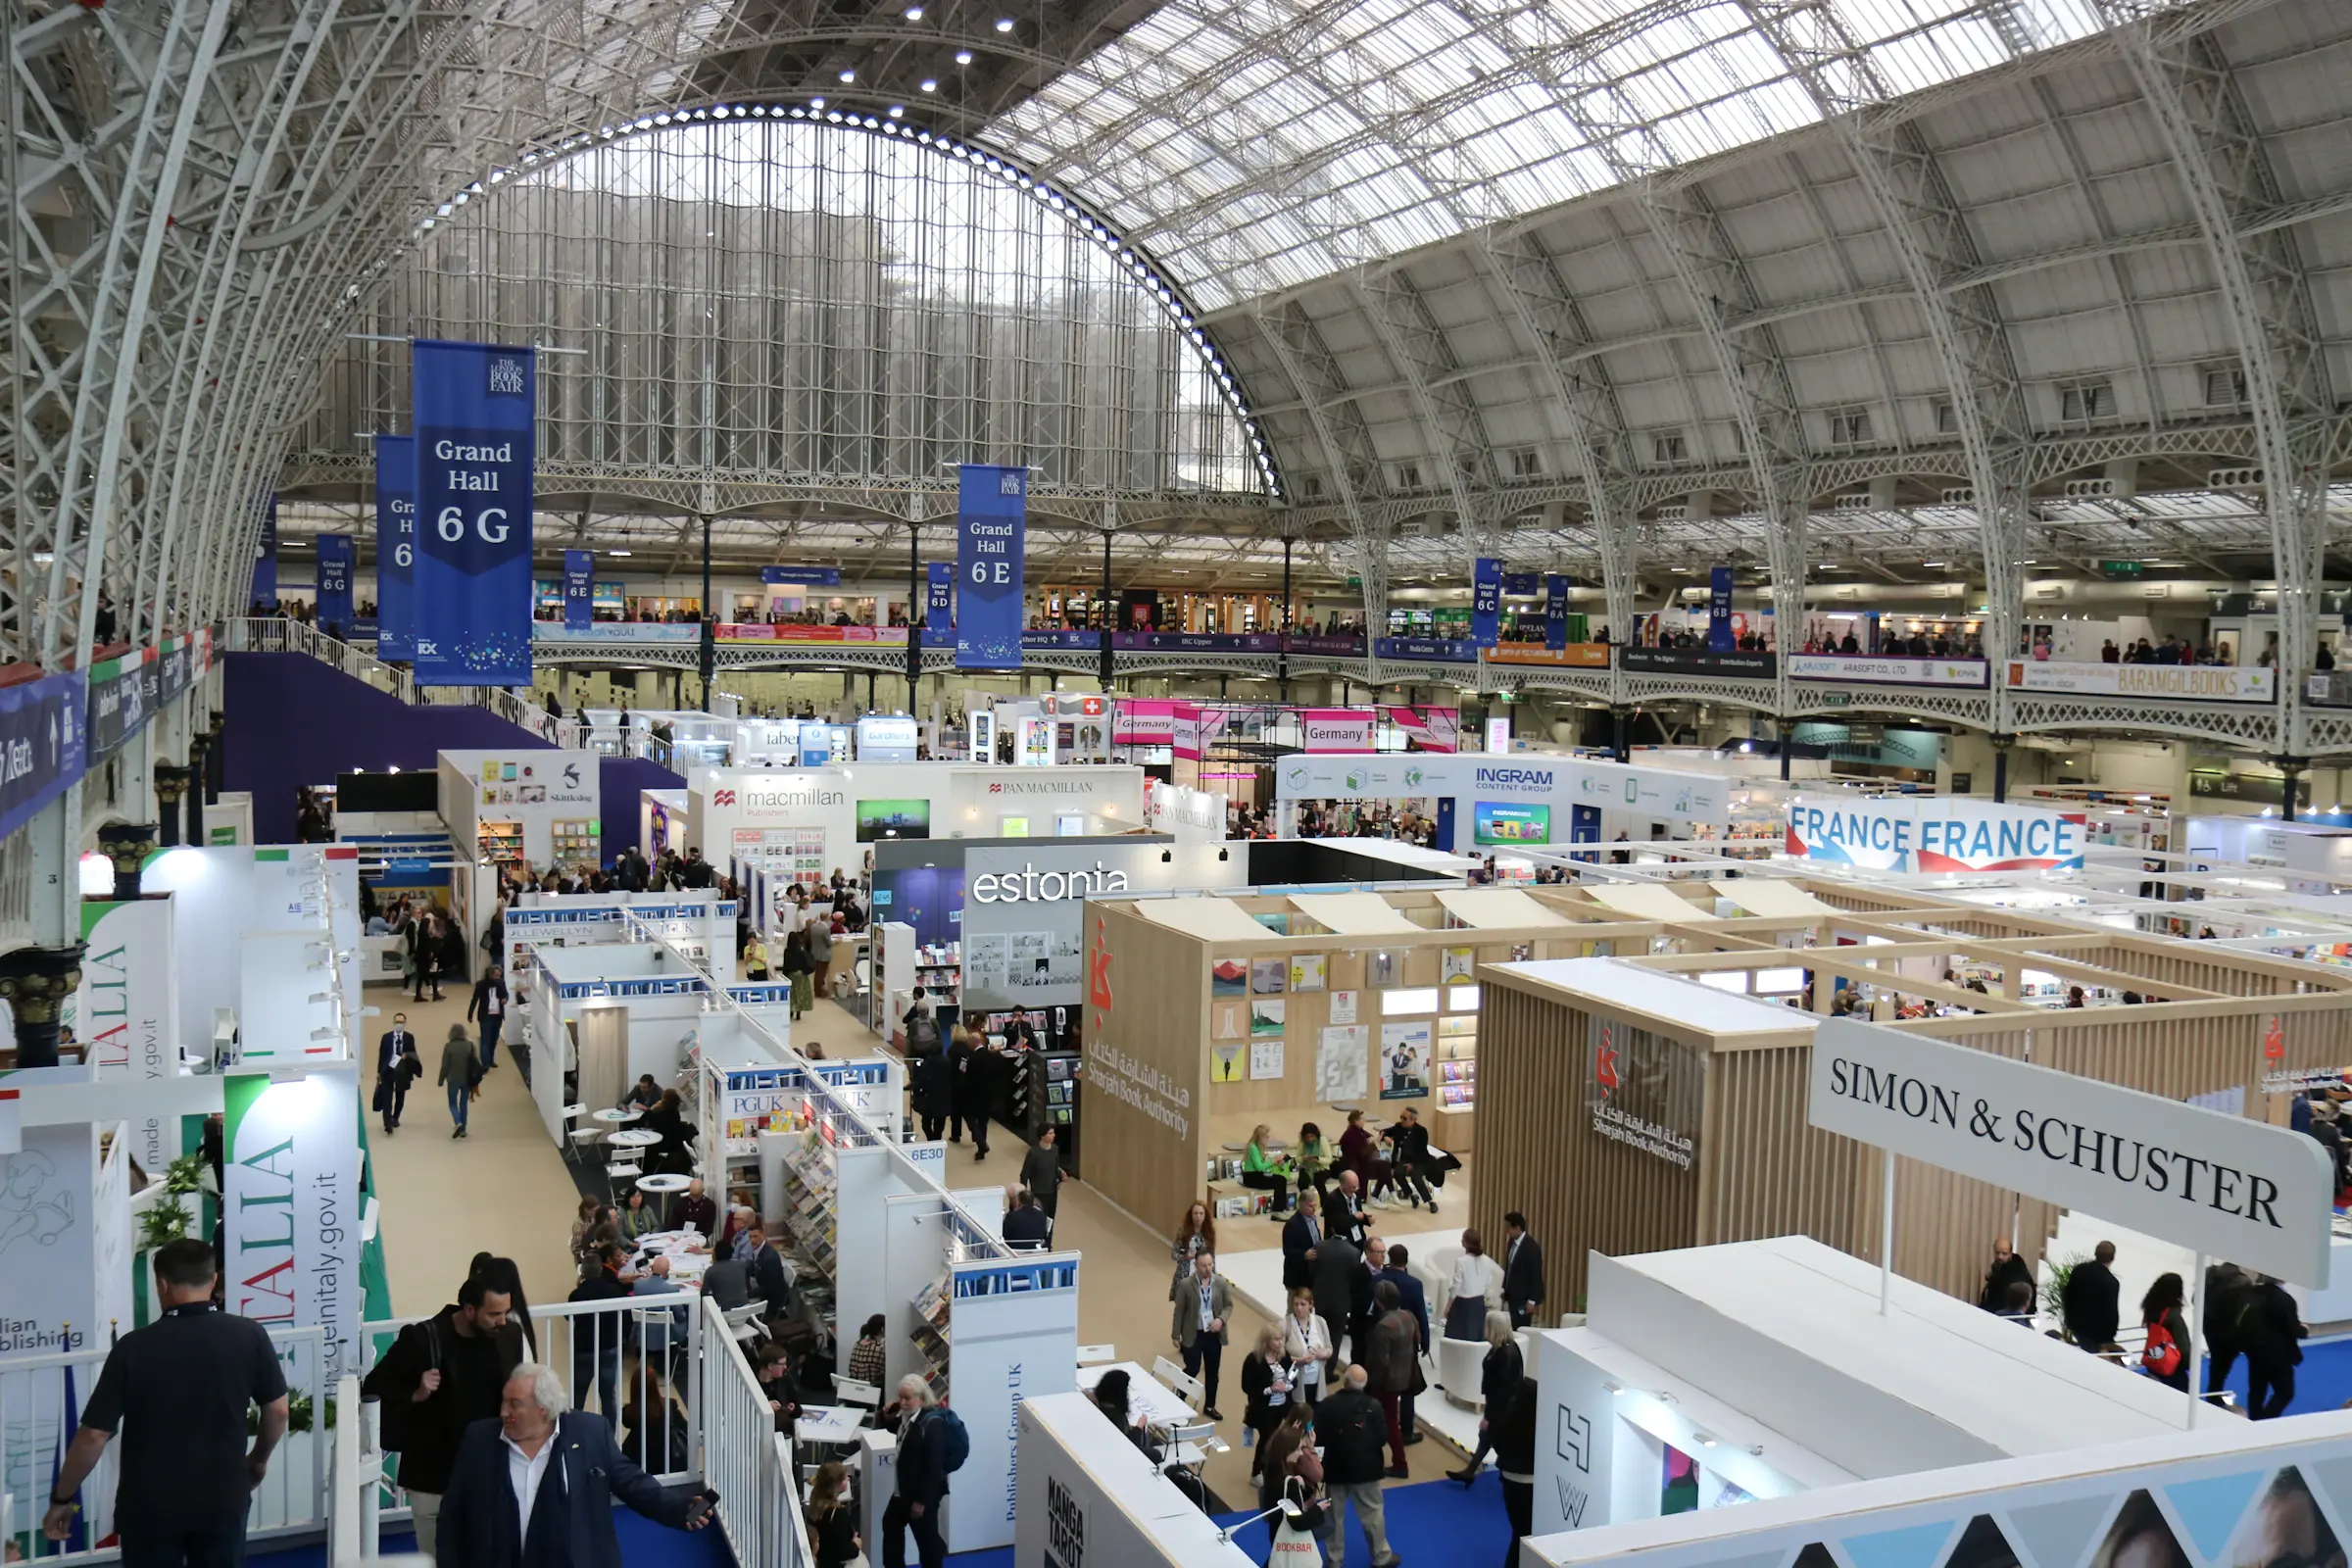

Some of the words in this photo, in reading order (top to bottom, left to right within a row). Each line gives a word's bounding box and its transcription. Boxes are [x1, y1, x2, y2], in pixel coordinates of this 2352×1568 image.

[490, 370, 523, 383] BOOK
[490, 381, 523, 393] FAIR
[435, 440, 512, 463] Grand
[449, 469, 500, 491] Hall
[391, 499, 416, 514] Gra
[438, 507, 465, 542] 6
[476, 508, 510, 544] G
[970, 522, 1013, 536] Grand
[395, 543, 413, 566] 6
[977, 540, 1005, 554] Hall
[971, 562, 987, 584] 6
[994, 562, 1010, 584] E
[323, 579, 332, 590] 6
[335, 579, 345, 590] G
[570, 587, 577, 597] 6
[580, 587, 587, 597] E
[931, 598, 939, 607] 6
[939, 598, 948, 607] D
[1478, 601, 1485, 611] 6
[1485, 601, 1494, 611] C
[2248, 599, 2266, 611] Lift
[1550, 610, 1556, 618] 6
[1556, 610, 1563, 618] A
[1714, 608, 1720, 617] 6
[1721, 608, 1727, 617] B
[1022, 635, 1037, 644] thor
[1194, 638, 1212, 647] Upper
[417, 643, 437, 655] RX
[1842, 663, 1876, 673] ARASOFT
[2118, 668, 2238, 696] BARAMGILBOOKS
[1123, 718, 1172, 730] Germany
[766, 730, 800, 745] faber
[1310, 727, 1363, 742] Germany
[1477, 767, 1552, 785] INGRAM
[1004, 782, 1025, 794] PAN
[1028, 782, 1093, 794] MACMILLAN
[1476, 782, 1518, 792] CONTENT
[1521, 784, 1552, 793] GROUP
[2221, 782, 2237, 793] Lift
[551, 794, 593, 803] Skittledog
[747, 789, 844, 807] macmillan
[748, 808, 789, 817] Publishers
[1174, 808, 1218, 831] MACMILLAN
[1791, 806, 1911, 856] FRANCE
[1921, 818, 2076, 858] FRANCE
[973, 860, 1128, 904] estonia
[516, 925, 594, 938] LLEWELLYN
[90, 944, 129, 1070] TALIA
[734, 1095, 785, 1113] PGUK
[1088, 1061, 1119, 1097] Sharjah
[1119, 1084, 1143, 1110] Book
[1143, 1096, 1189, 1142] Authority
[1593, 1118, 1624, 1142] Sharjah
[1625, 1130, 1647, 1152] Book
[1646, 1141, 1690, 1171] Authority
[1831, 1057, 1960, 1130] SIMON
[1969, 1098, 2005, 1144] &
[2014, 1109, 2284, 1229] SCHUSTER
[911, 1148, 944, 1161] 6E30
[311, 1172, 344, 1397] einitaly.gov.it
[0, 1317, 37, 1334] lian
[0, 1330, 83, 1351] blishing
[1007, 1362, 1022, 1388] UK
[1006, 1393, 1021, 1440] Group
[1005, 1445, 1018, 1522] Publishers
[1048, 1475, 1084, 1546] MANGA
[1048, 1509, 1083, 1568] TAROT
[1276, 1543, 1312, 1552] BOOKBAR
